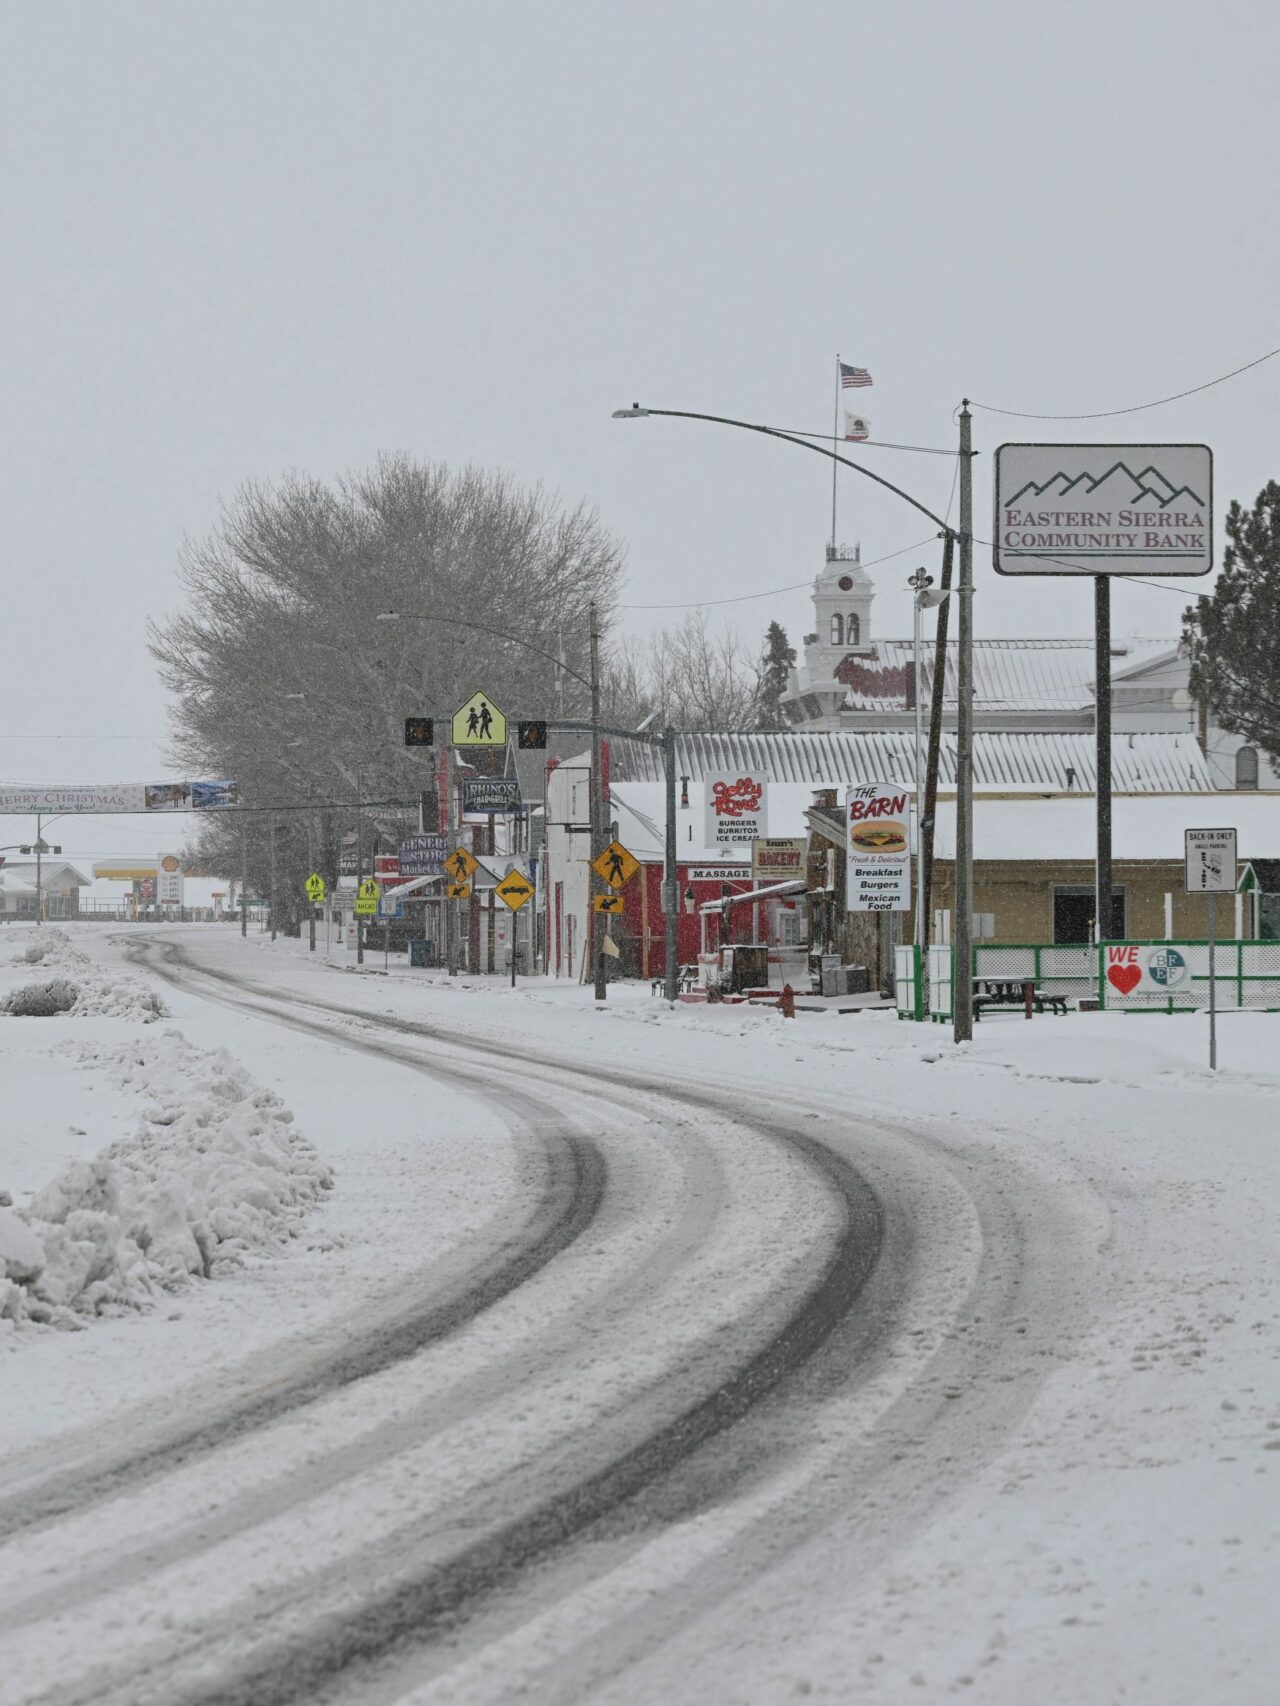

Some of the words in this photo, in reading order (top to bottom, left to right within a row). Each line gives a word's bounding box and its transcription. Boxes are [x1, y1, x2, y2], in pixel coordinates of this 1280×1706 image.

[1004, 509, 1112, 527] EASTERN
[1118, 509, 1206, 528] SIERRA
[1004, 531, 1138, 548] COMMUNITY
[1143, 531, 1206, 549] BANK
[469, 783, 516, 797] RHINO'S
[712, 777, 763, 800] Jolly
[854, 786, 878, 798] THE
[44, 792, 126, 806] CHRISTMAS
[849, 794, 907, 821] BARN
[1189, 832, 1215, 840] BACK-IN
[1216, 832, 1233, 840] ONLY
[402, 837, 448, 851] GENER
[757, 851, 801, 866] BAKERY
[401, 864, 431, 875] Market
[692, 870, 750, 878] MASSAGE
[855, 868, 903, 877] Breakfast
[860, 880, 899, 889] Burgers
[858, 894, 901, 902] Mexican
[357, 902, 376, 910] AHEAD
[867, 902, 893, 910] Food
[1108, 946, 1140, 963] WE
